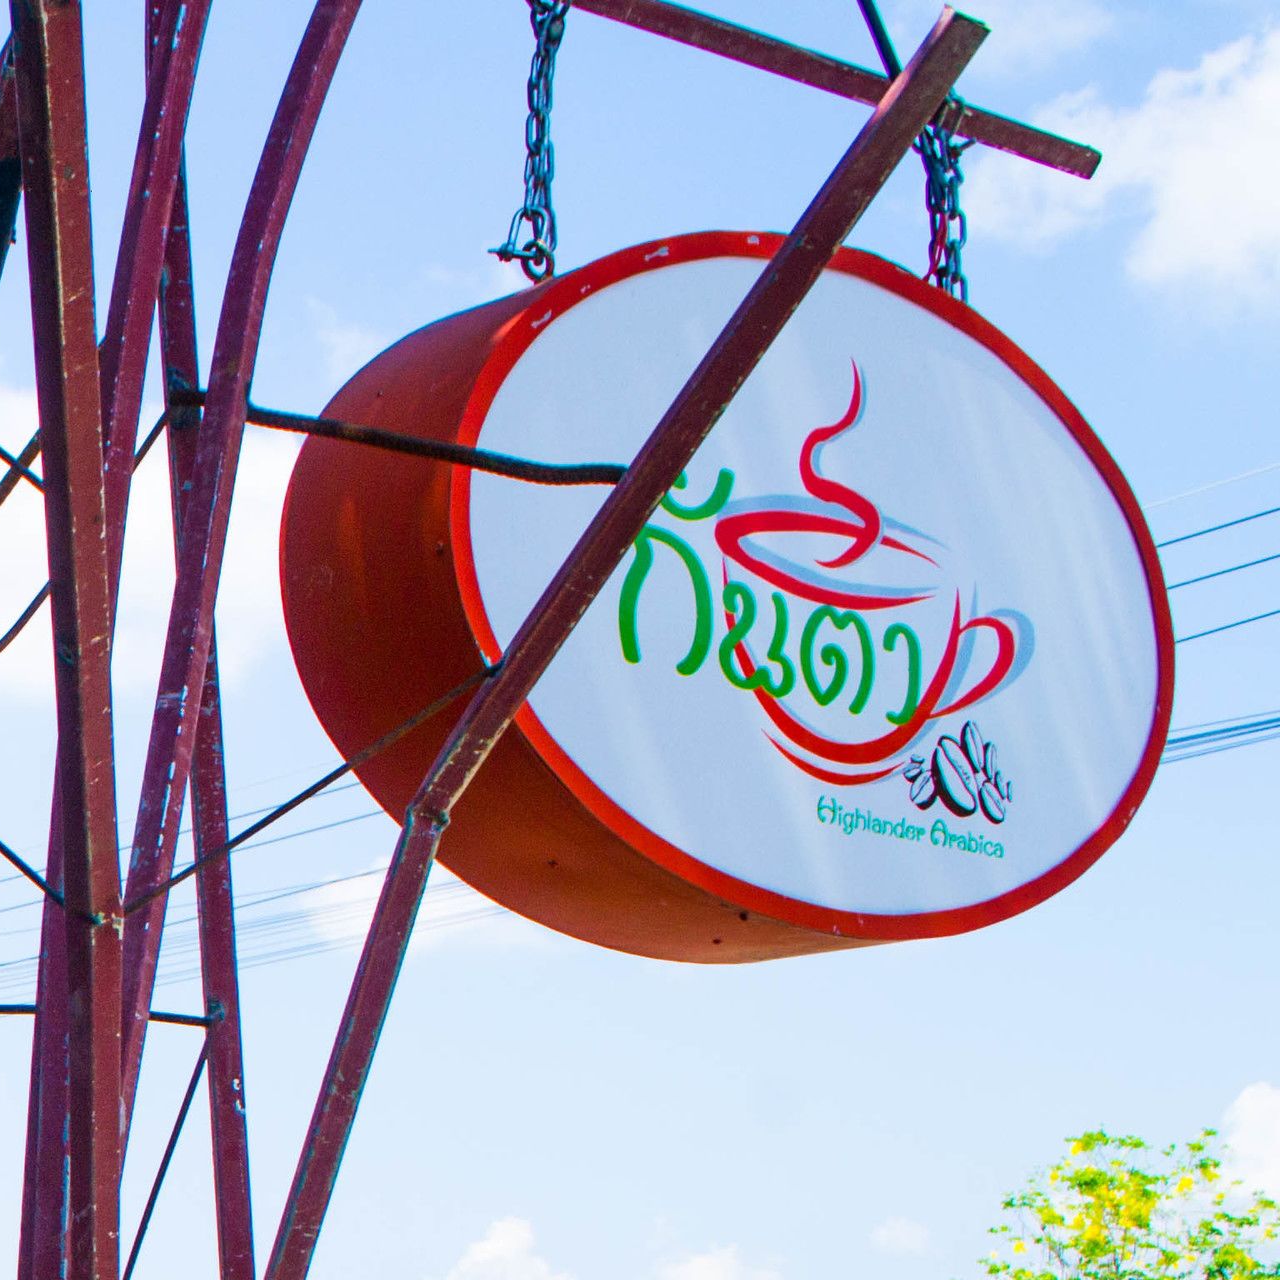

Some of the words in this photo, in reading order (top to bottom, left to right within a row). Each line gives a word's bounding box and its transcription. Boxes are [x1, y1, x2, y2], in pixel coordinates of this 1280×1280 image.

[618, 466, 923, 726] กันตา
[816, 795, 926, 842] Highlander
[930, 818, 1005, 859] Arabica
